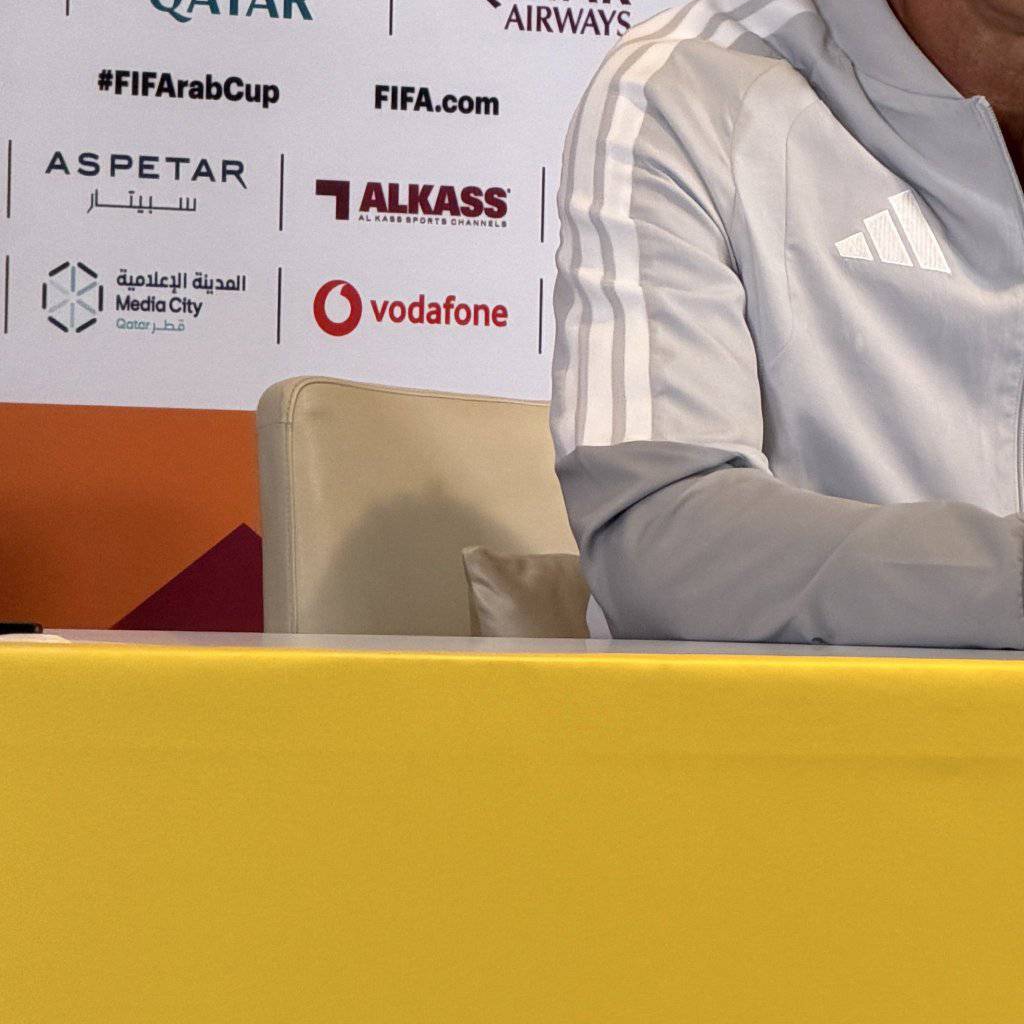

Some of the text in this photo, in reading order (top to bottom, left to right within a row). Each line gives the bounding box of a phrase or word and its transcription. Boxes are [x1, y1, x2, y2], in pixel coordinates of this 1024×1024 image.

[504, 4, 631, 37] AIRWAYS
[98, 70, 279, 108] #FIFArabCup
[375, 85, 499, 115] FIFA.com
[45, 151, 247, 189] ASPETAR
[359, 182, 509, 219] ALKASS
[358, 214, 371, 222] AL
[406, 217, 447, 226] SPORTS
[451, 218, 507, 228] CHANNELS
[116, 269, 246, 294] المدينة الإعلامية
[116, 295, 202, 317] Media City
[371, 294, 508, 327] vodafone
[116, 318, 151, 330] Qatar
